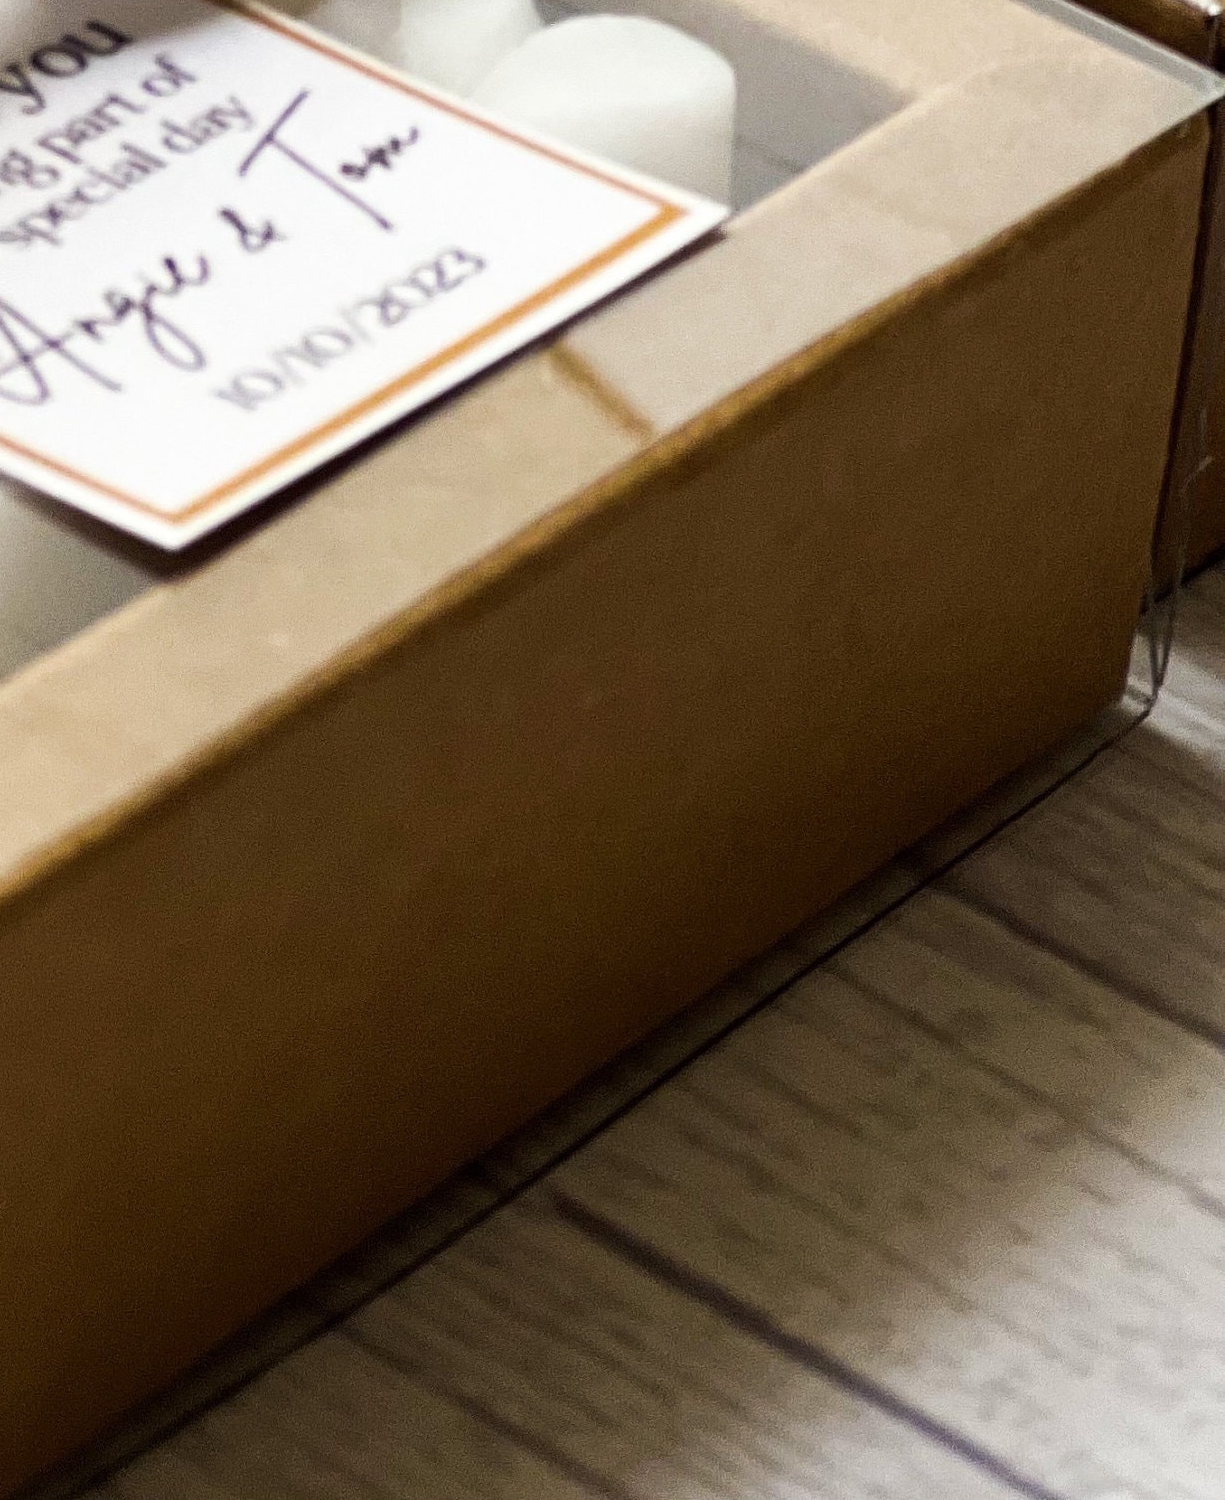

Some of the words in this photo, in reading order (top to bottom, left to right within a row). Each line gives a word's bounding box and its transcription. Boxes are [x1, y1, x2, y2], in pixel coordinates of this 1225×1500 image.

[37, 93, 146, 165] part
[140, 52, 199, 98] of
[160, 94, 256, 155] day
[215, 247, 488, 411] 10/10/2023
